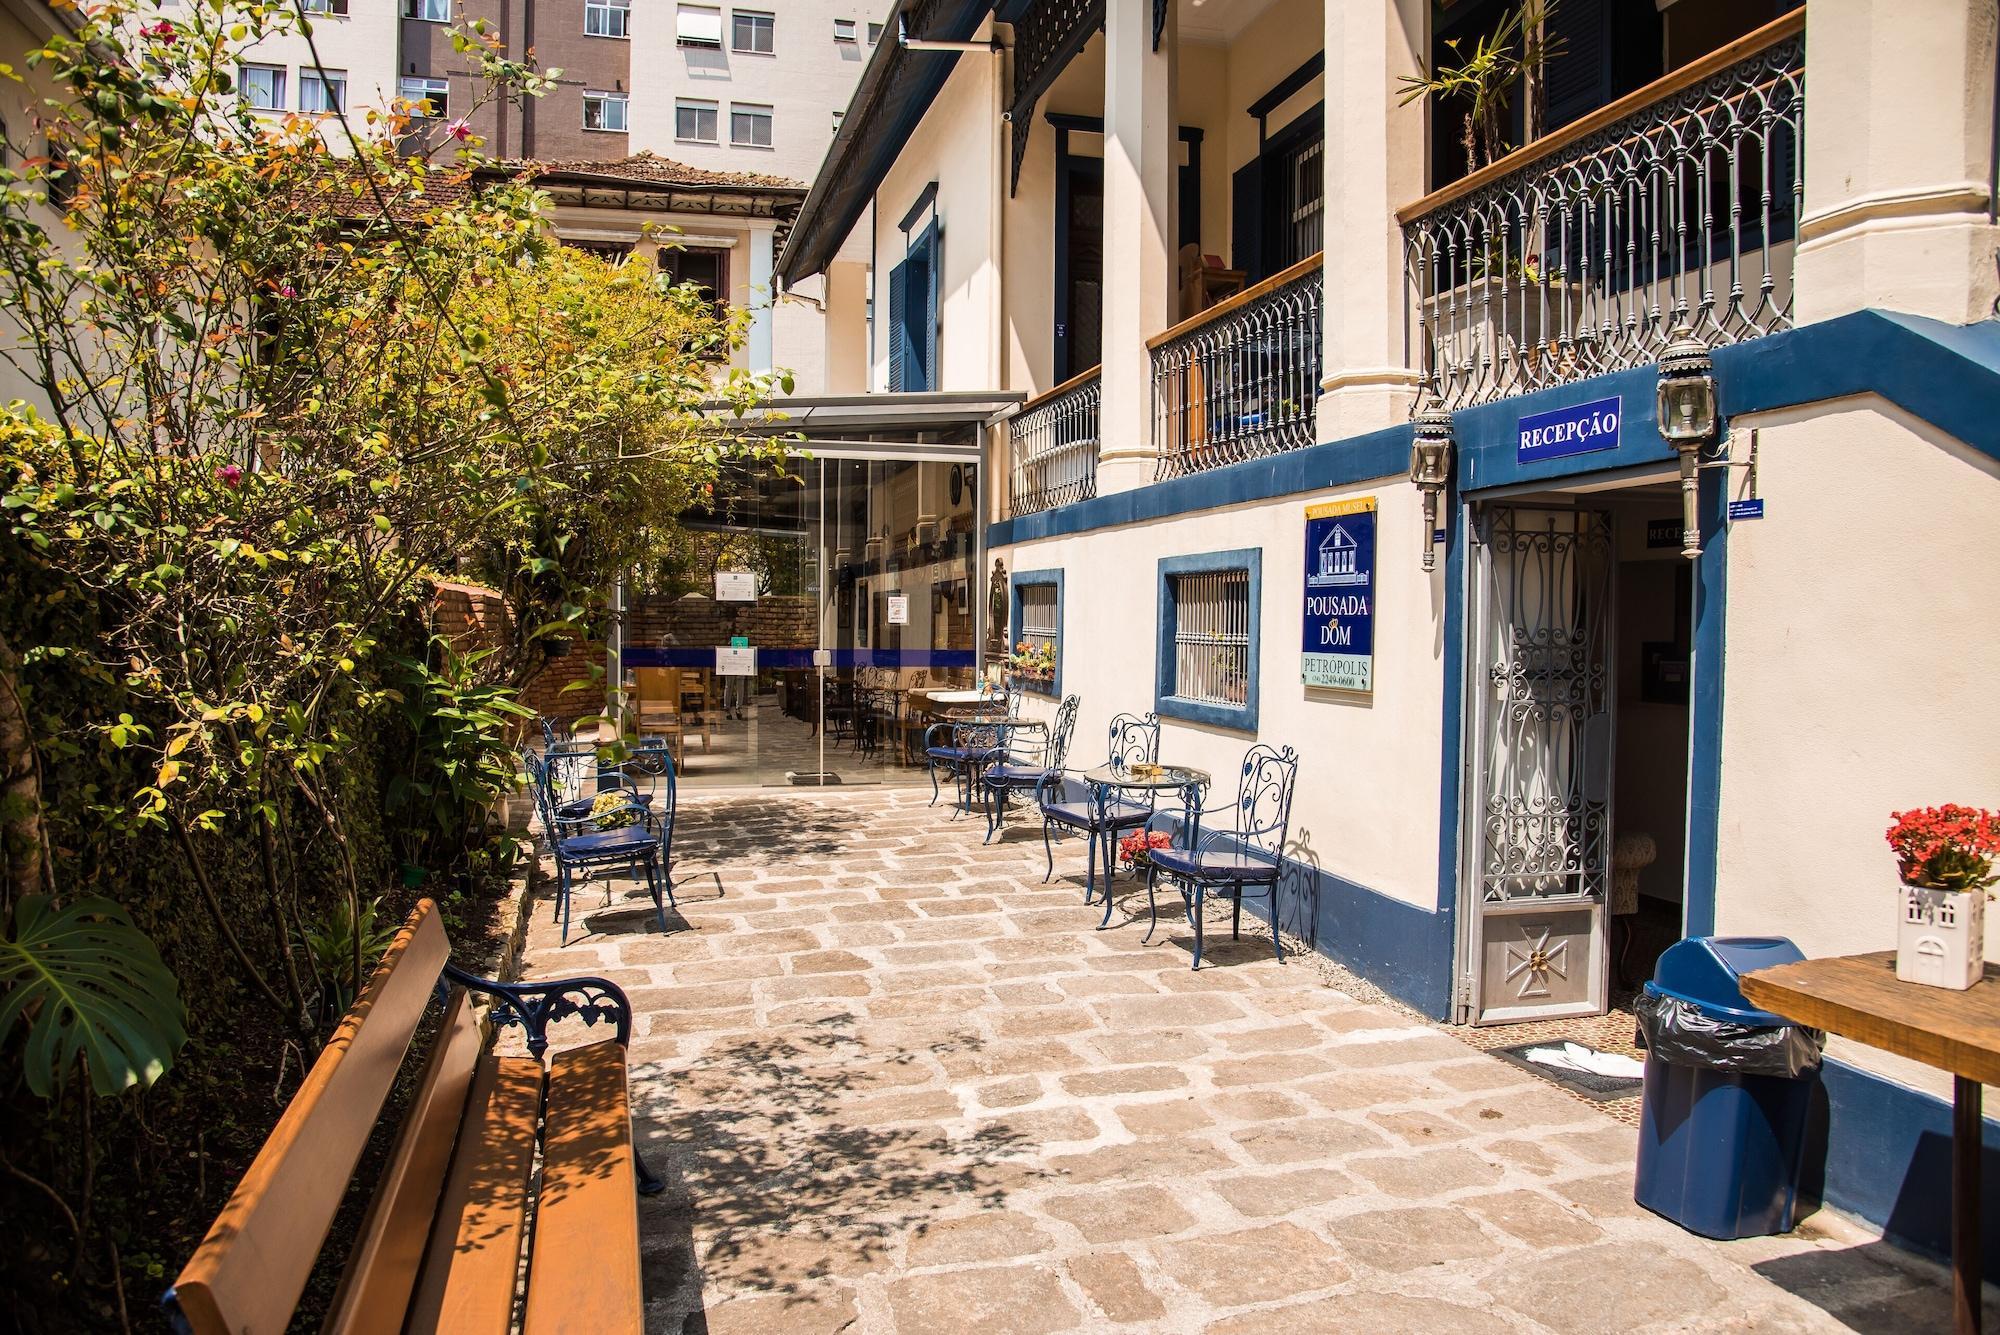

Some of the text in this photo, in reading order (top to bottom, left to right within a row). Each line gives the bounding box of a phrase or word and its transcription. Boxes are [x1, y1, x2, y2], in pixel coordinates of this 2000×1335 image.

[1519, 411, 1617, 449] RECEPÇÃO
[1649, 527, 1681, 540] RECE
[1306, 596, 1368, 616] POUSADA
[1320, 625, 1352, 646] DOM
[1304, 656, 1368, 676] PETRÓPOLIS
[1321, 674, 1355, 687] 2249-0600
